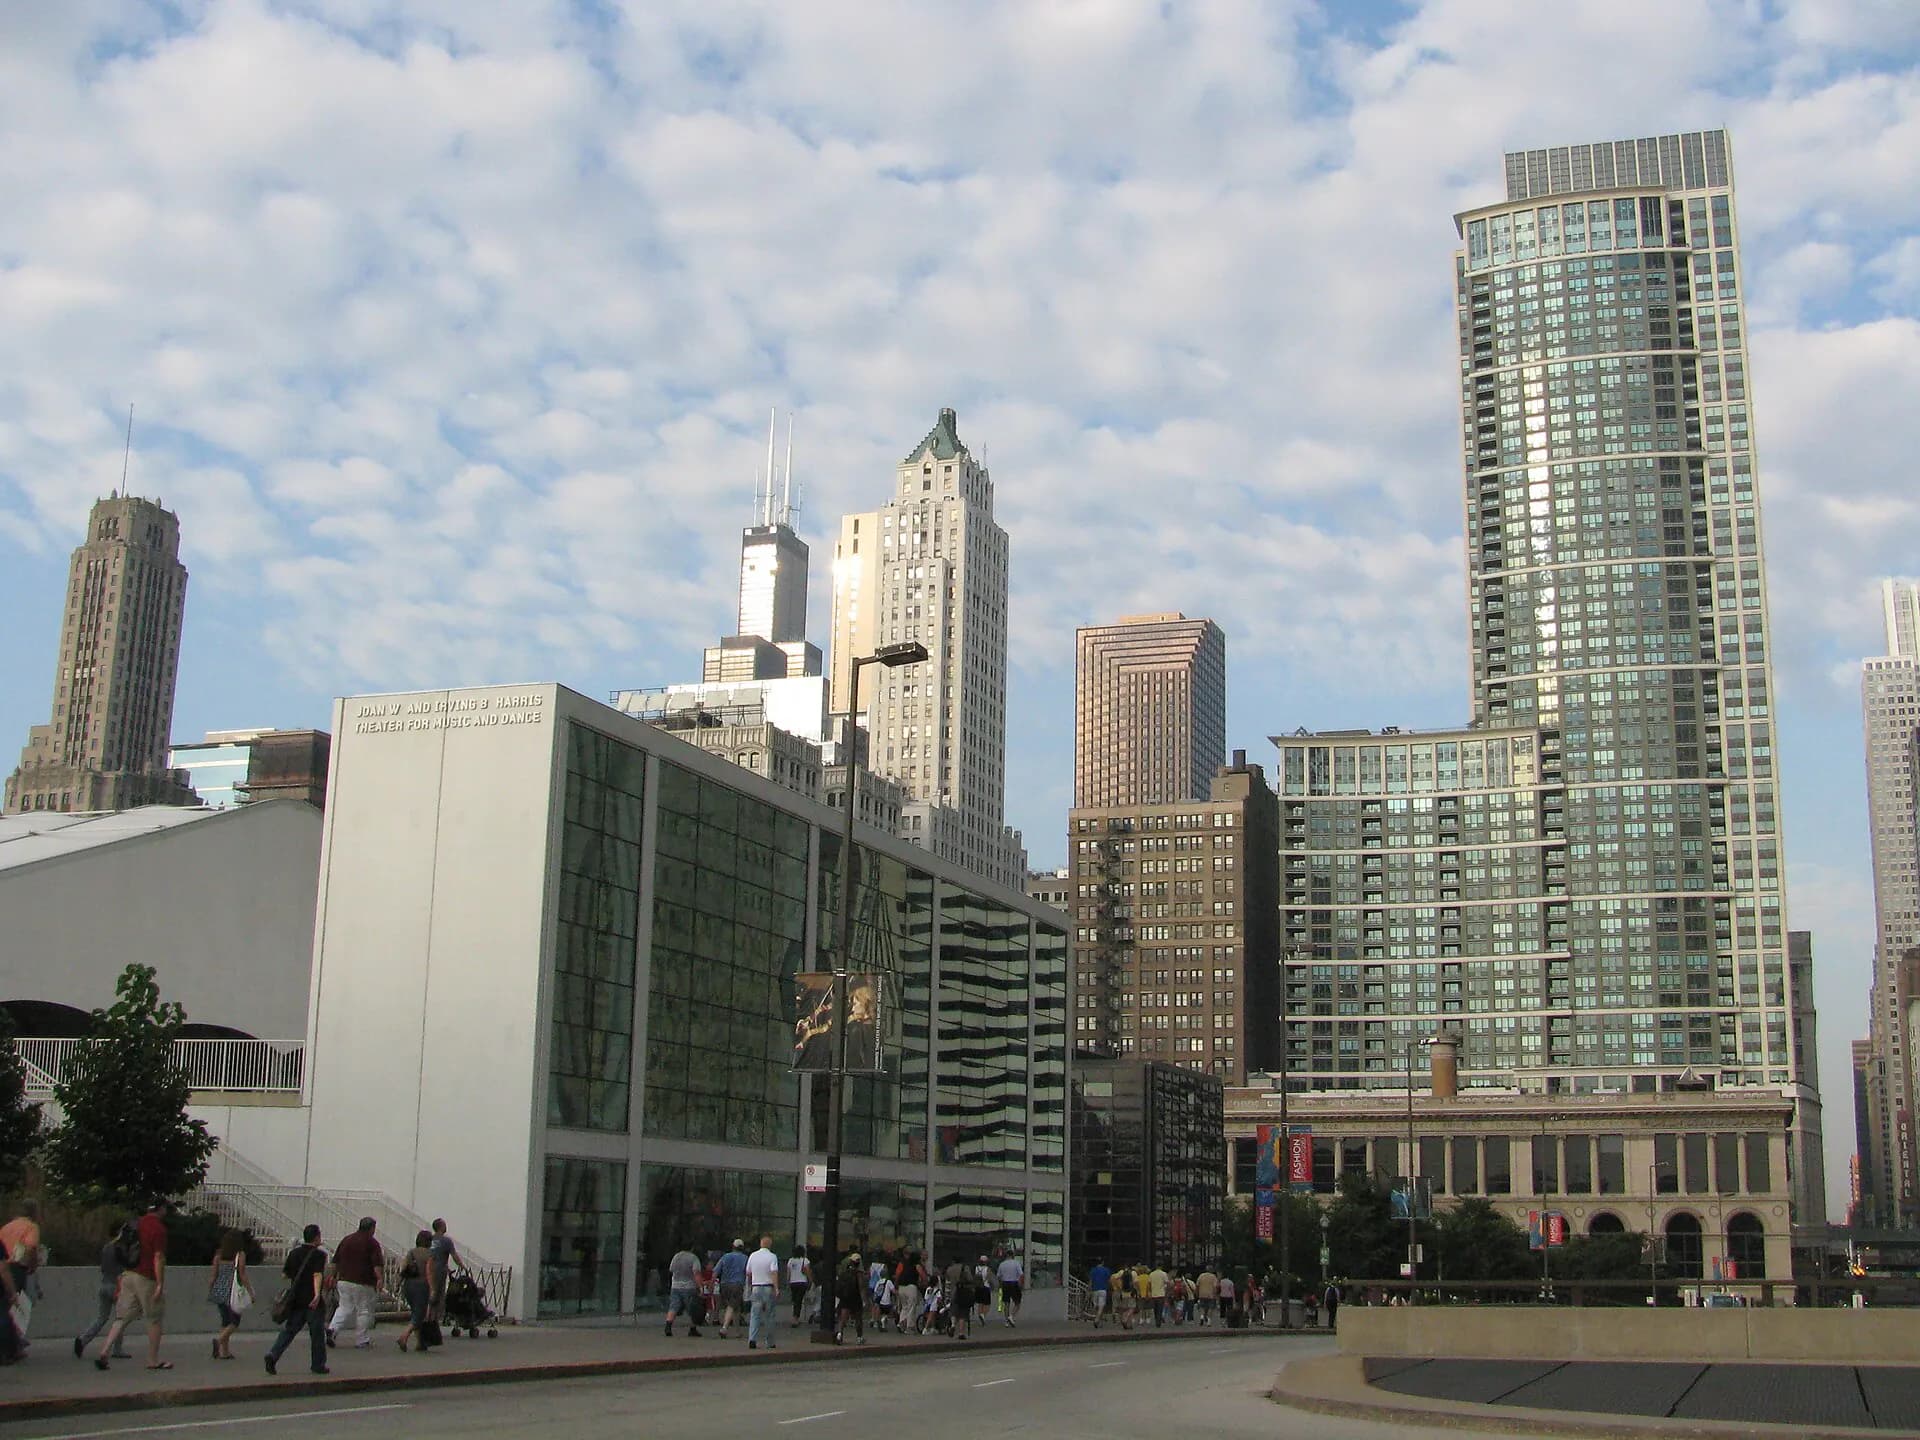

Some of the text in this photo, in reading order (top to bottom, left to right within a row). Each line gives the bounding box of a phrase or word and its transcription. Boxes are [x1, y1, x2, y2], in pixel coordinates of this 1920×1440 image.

[357, 694, 543, 718] JOAN W AND IRVING B HARRIS
[355, 711, 541, 734] THEATER FOR MUSIC AND DANCE
[1292, 1139, 1302, 1179] FASHION
[1900, 1122, 1911, 1198] ORIENTAL
